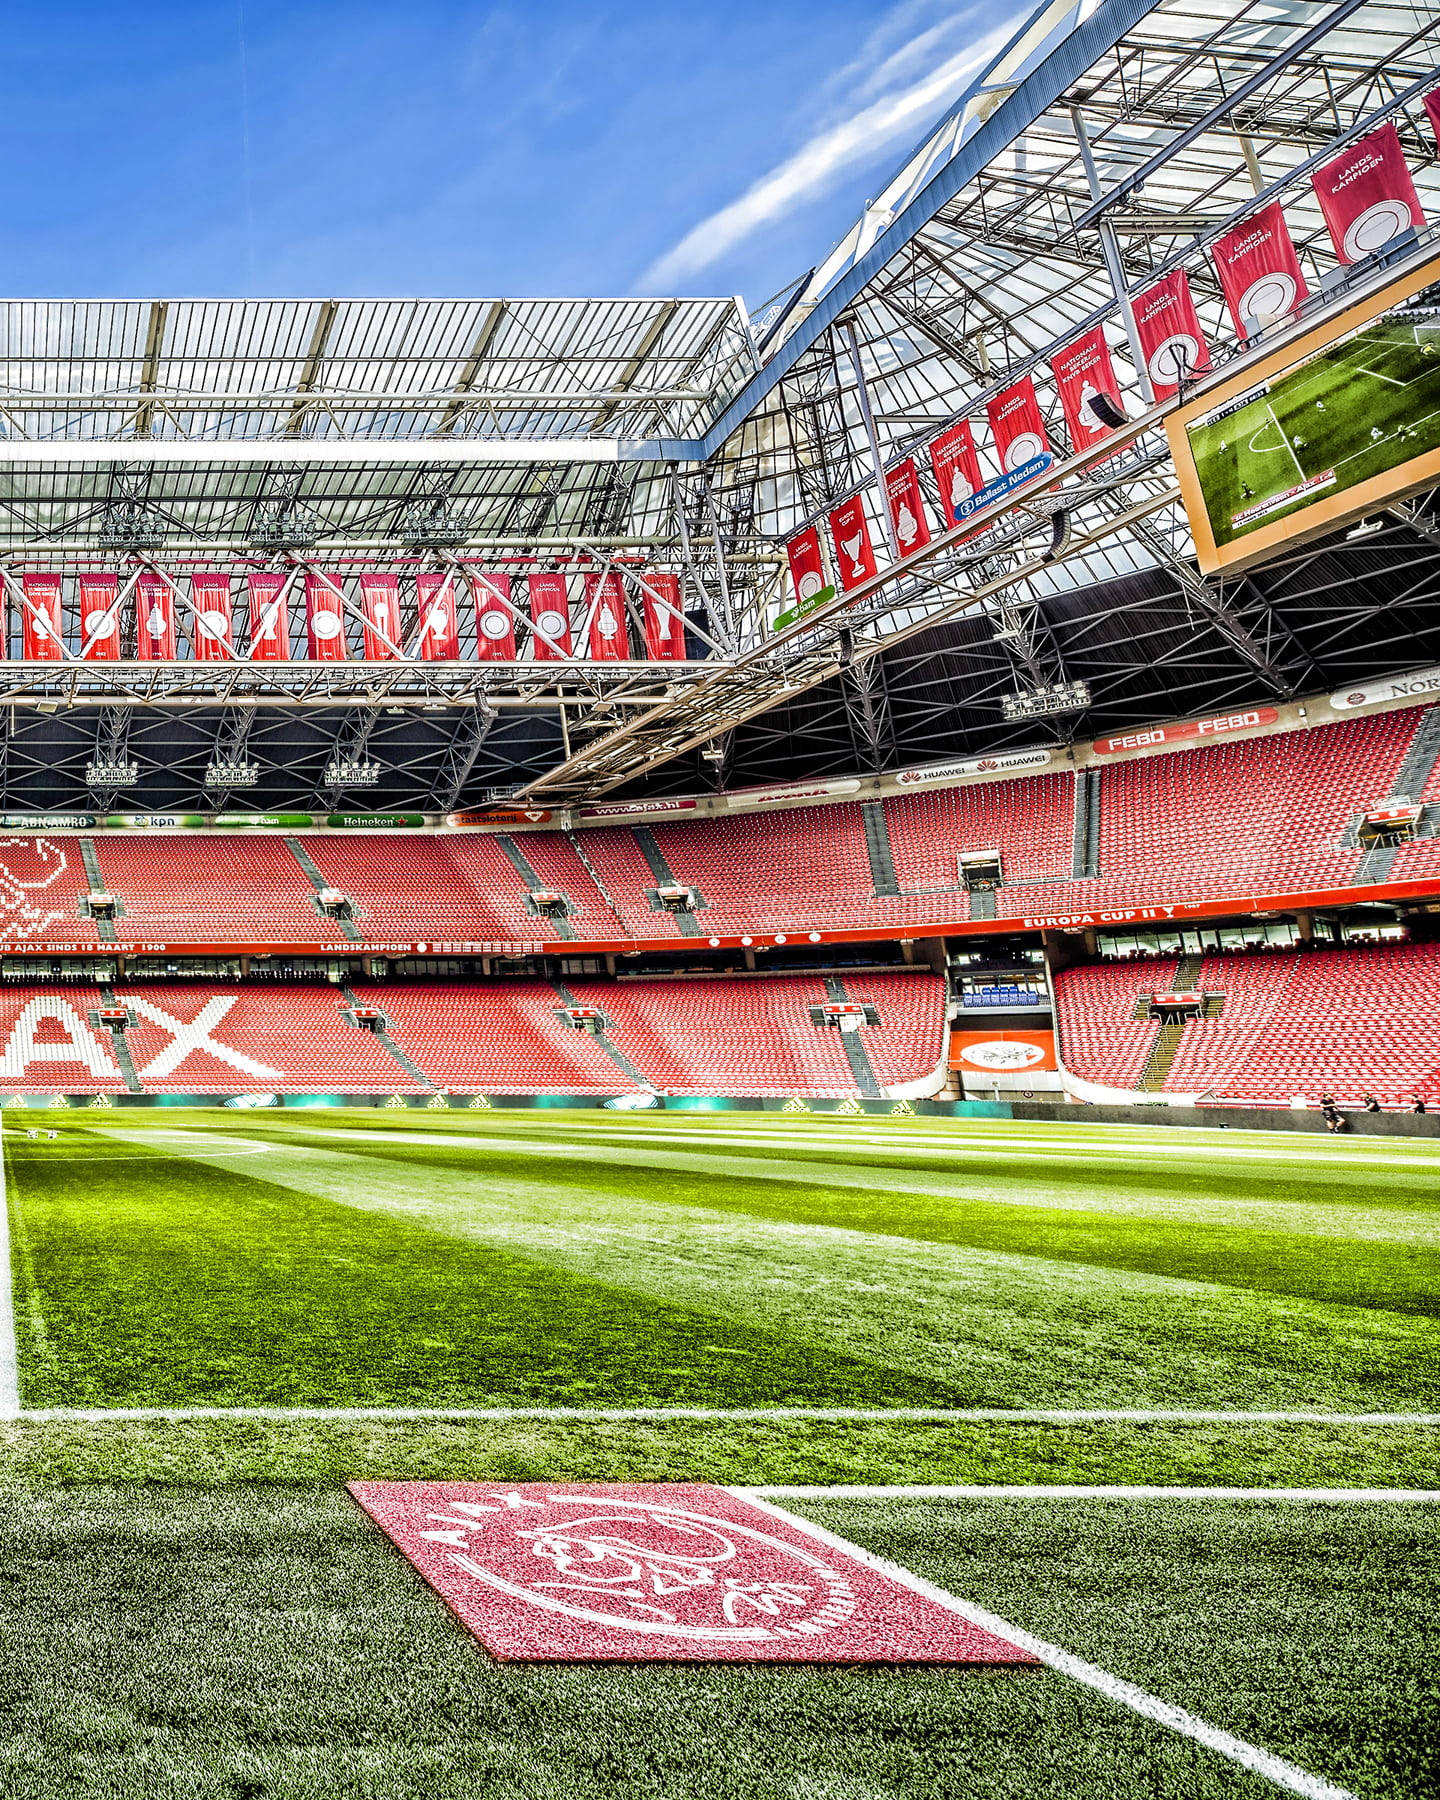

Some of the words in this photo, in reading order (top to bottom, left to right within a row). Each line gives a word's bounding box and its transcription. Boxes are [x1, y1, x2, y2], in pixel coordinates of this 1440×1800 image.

[1331, 155, 1384, 193] KAMPIOEN
[1338, 154, 1372, 180] LANDS
[1228, 230, 1272, 264] KAMPIOEN
[1233, 229, 1262, 252] LANDS
[1140, 295, 1178, 324] KAMPIOEN
[1145, 293, 1170, 312] LANDS
[1060, 342, 1097, 371] NATIONALE
[974, 482, 1008, 506] Ballast
[1008, 460, 1044, 485] Nedam
[800, 600, 815, 612] bam
[1109, 730, 1165, 751] FEBO
[1198, 712, 1259, 734] FEBO
[924, 768, 965, 779] HUAWEI
[1000, 755, 1045, 768] HUAWEI
[150, 815, 175, 827] kpn
[344, 817, 394, 827] Heineken
[1024, 915, 1094, 928] EUROPA
[1100, 911, 1136, 921] CUP
[14, 944, 43, 952] AJAX
[46, 944, 77, 952] SINDS
[97, 944, 135, 952] MAART
[142, 944, 166, 952] 1900
[320, 943, 411, 951] LANDSKAMPIOEN
[418, 1490, 545, 1549] AJAX
